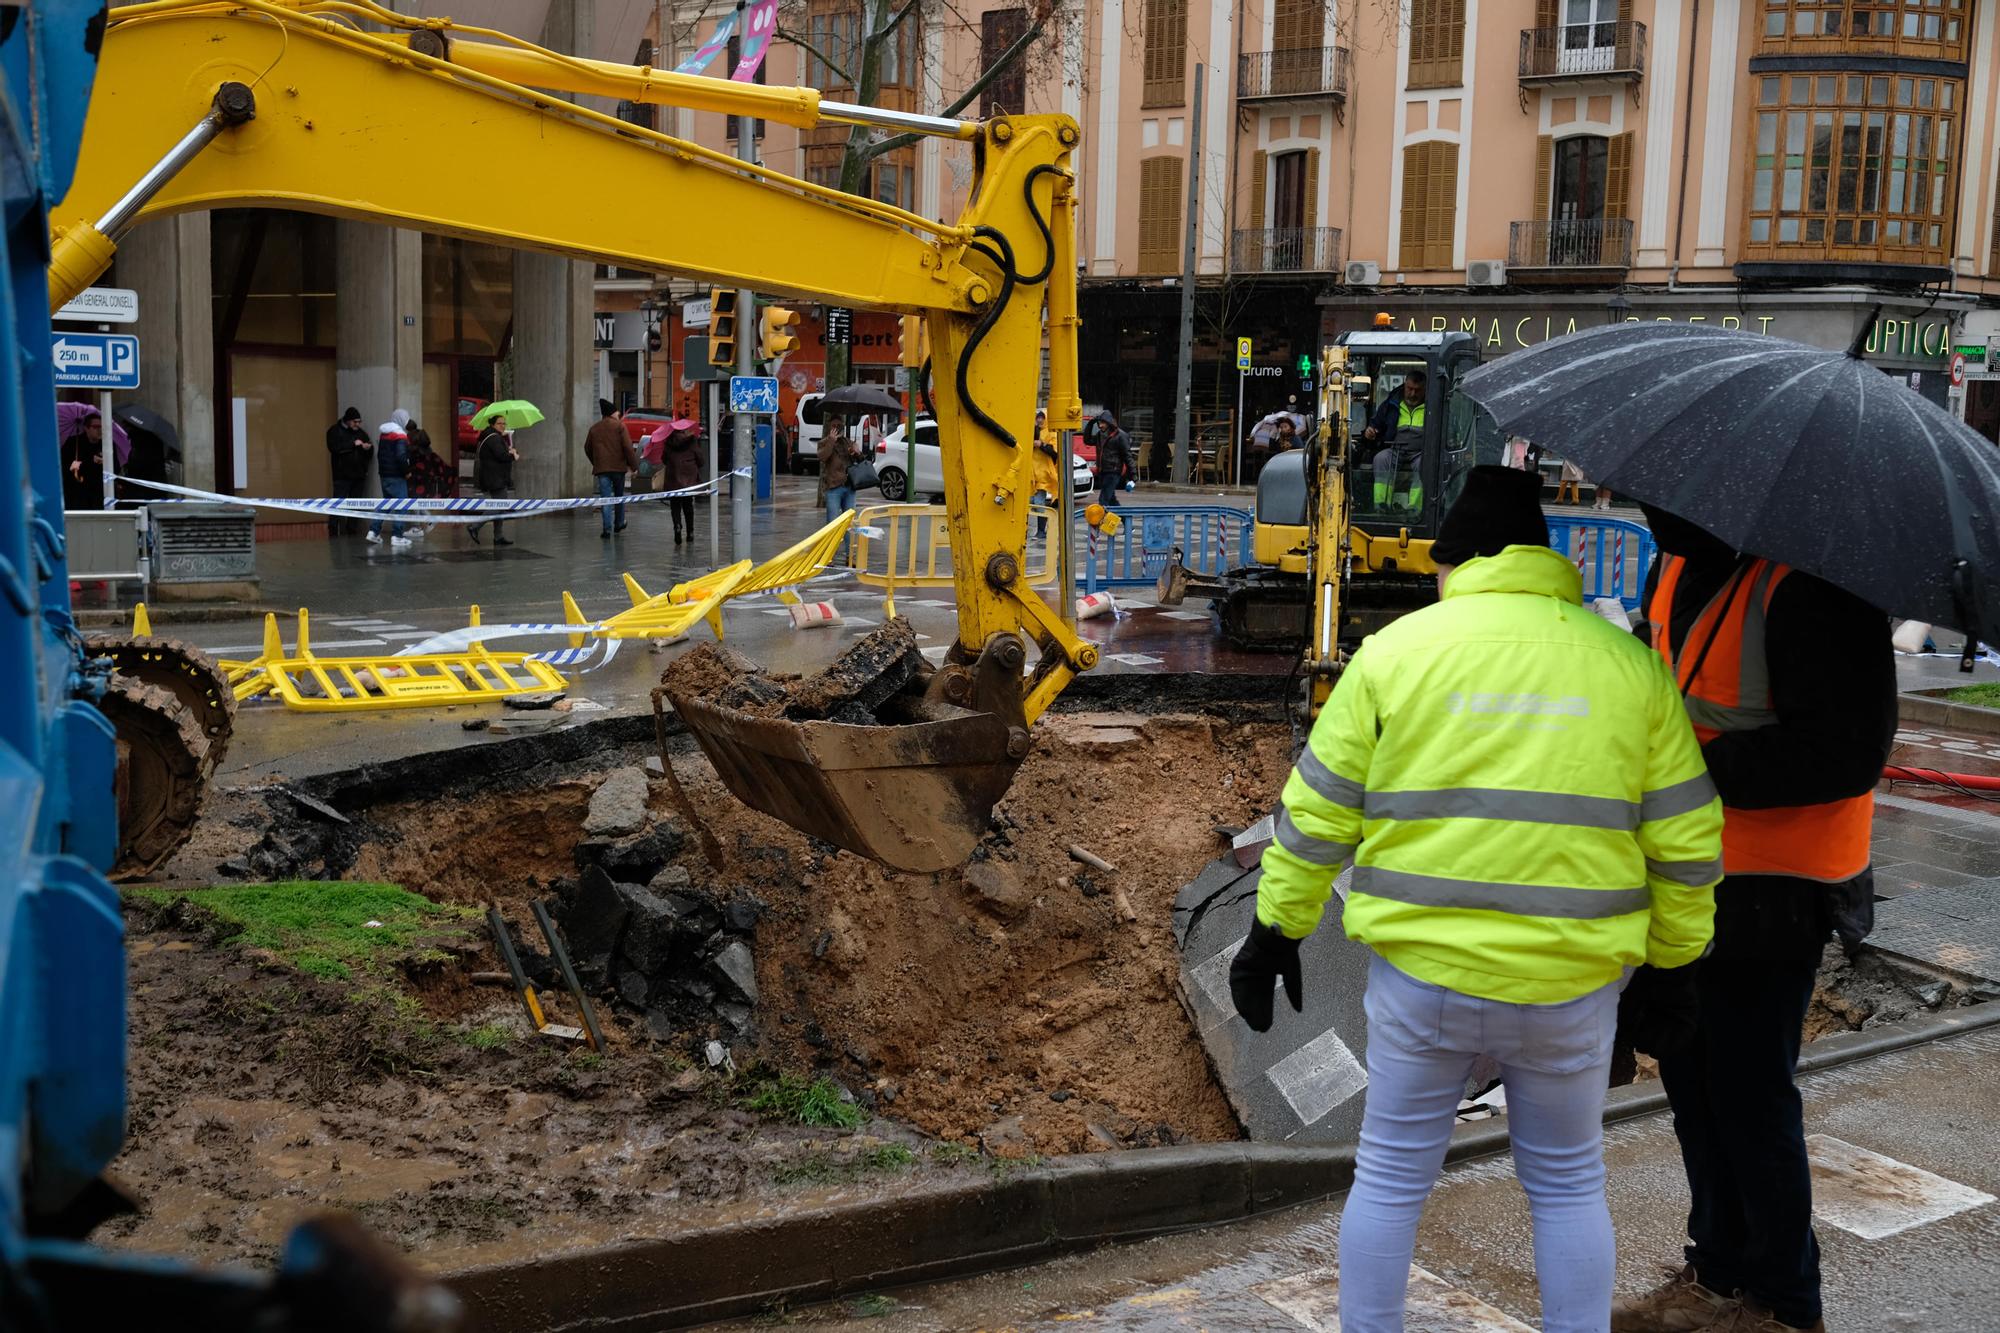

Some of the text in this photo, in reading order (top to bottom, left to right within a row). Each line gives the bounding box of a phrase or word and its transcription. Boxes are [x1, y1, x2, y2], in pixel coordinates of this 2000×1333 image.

[84, 294, 108, 307] GENERAL
[109, 295, 133, 309] CONSELL
[595, 318, 615, 341] NT
[1389, 316, 1577, 347] ARMACIA
[818, 332, 893, 346] epert
[60, 350, 89, 361] 250 m
[112, 343, 129, 371] P
[56, 373, 121, 382] PARKING PLAZA ESPAÑA
